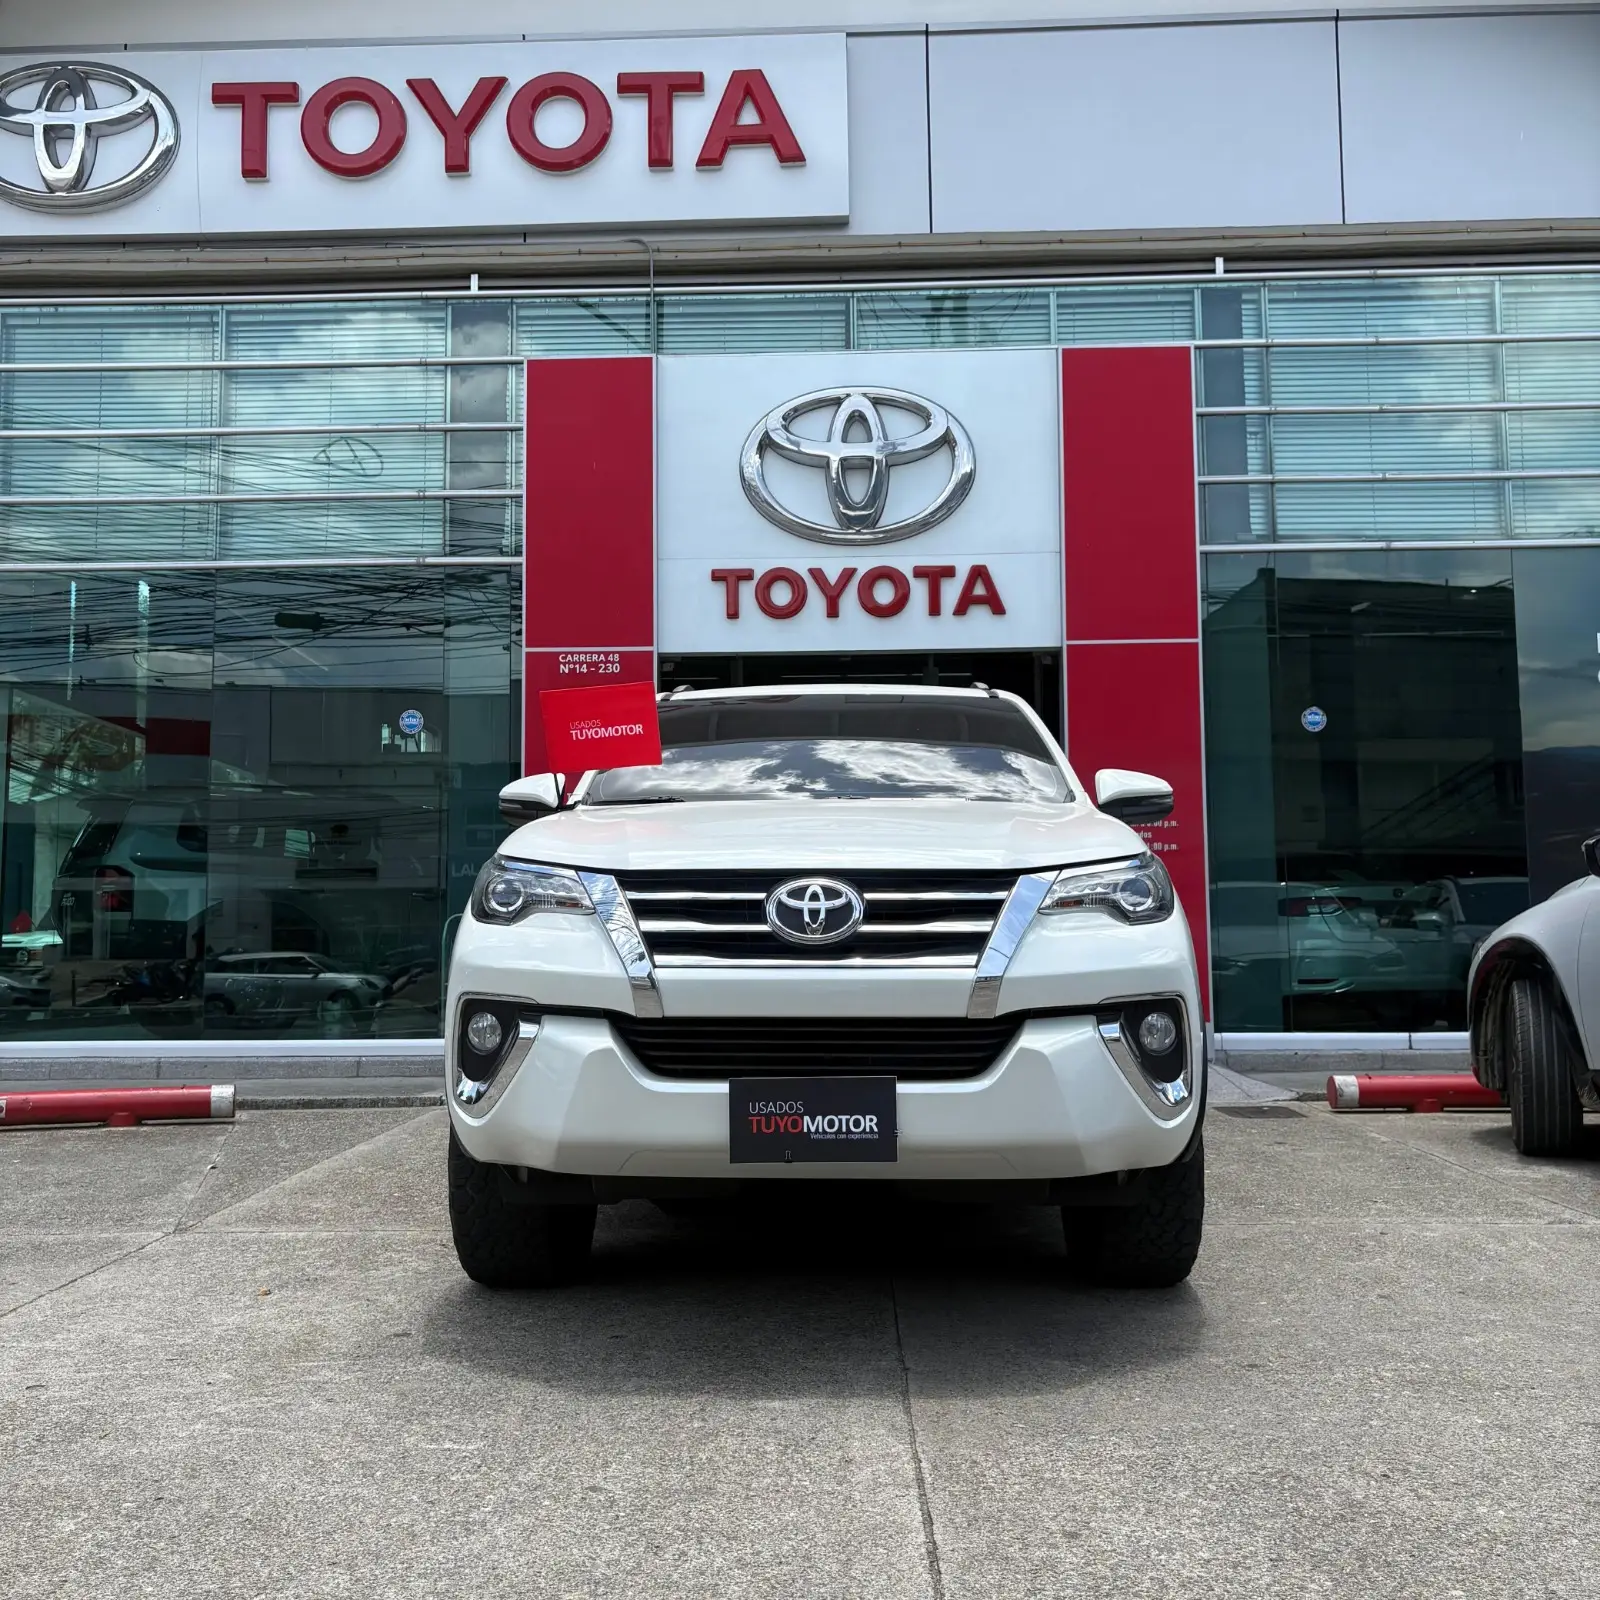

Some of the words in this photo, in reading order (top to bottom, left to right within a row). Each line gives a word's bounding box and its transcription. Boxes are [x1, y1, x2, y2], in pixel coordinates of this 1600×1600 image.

[211, 69, 805, 182] TOYOTA
[711, 565, 1006, 619] TOYOTA
[559, 653, 605, 663] CARRERA
[607, 653, 620, 662] 48
[598, 663, 620, 673] 230
[569, 720, 602, 730] USADOS
[570, 724, 644, 741] TUYOMOTOR
[749, 1101, 804, 1114] USADOS
[748, 1115, 879, 1134] TUYOMOTOR
